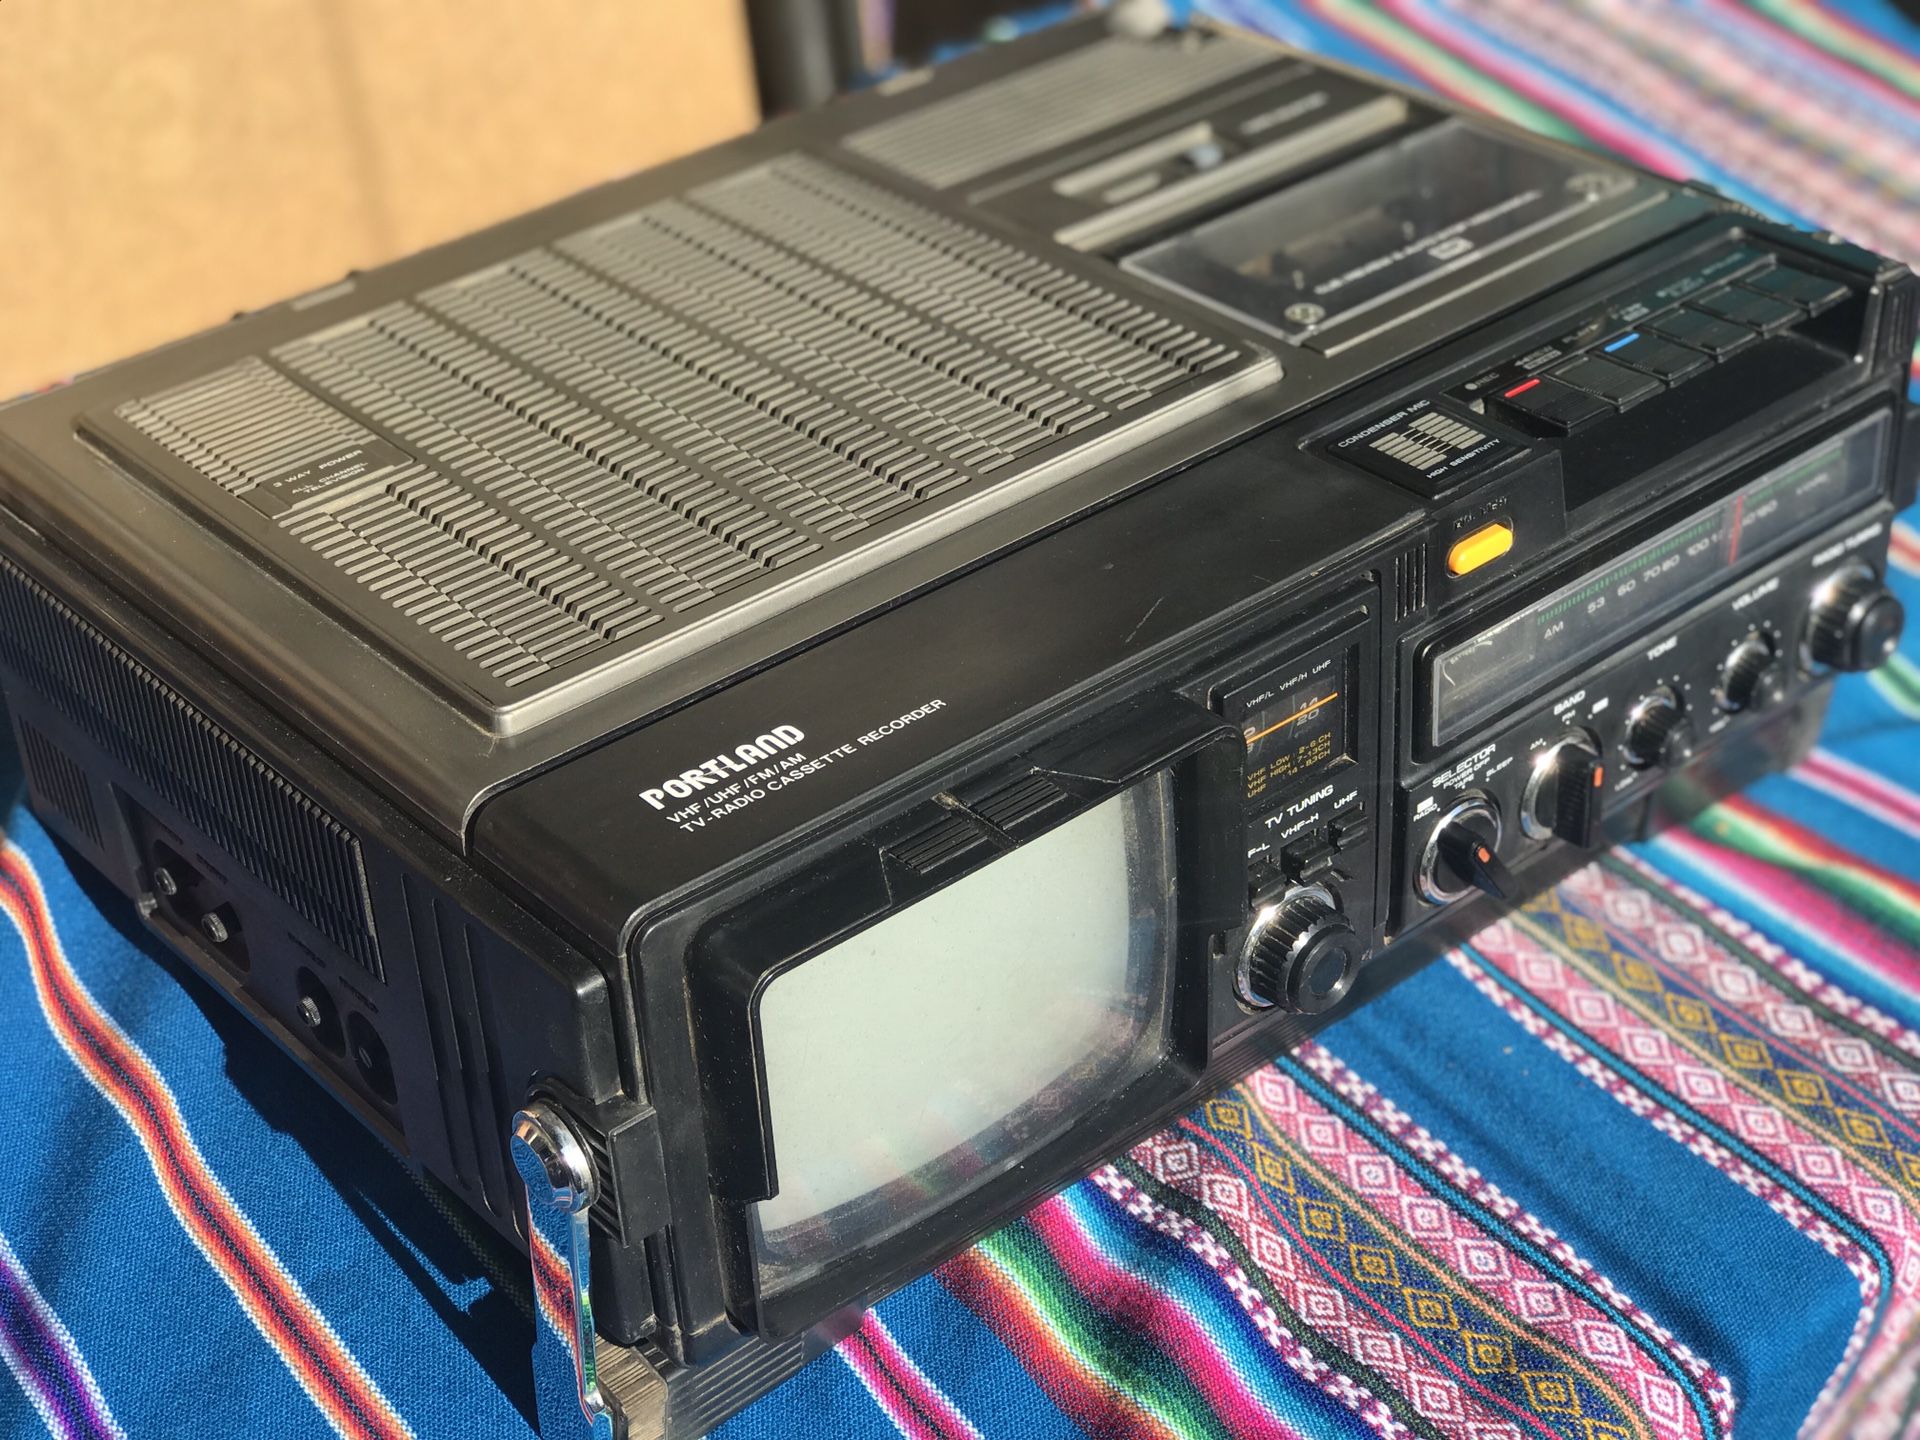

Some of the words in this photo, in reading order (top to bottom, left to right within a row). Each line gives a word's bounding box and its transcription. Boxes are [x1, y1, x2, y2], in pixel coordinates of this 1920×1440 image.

[1337, 410, 1408, 448] CONDENSER
[1407, 399, 1431, 413] MIC
[284, 469, 310, 482] WAY
[318, 449, 363, 469] POWER
[318, 462, 368, 482] CHANNEL
[1426, 466, 1449, 479] HIGH
[1449, 438, 1501, 467] SENSITIVITY
[304, 467, 365, 493] TELEVISION
[1544, 621, 1564, 640] AM
[1587, 596, 1605, 614] 53
[1617, 579, 1637, 597] 60
[1643, 565, 1661, 582] 70
[1647, 635, 1678, 660] TONE
[1246, 691, 1275, 708] VHF/L
[1279, 672, 1308, 691] VHF/H
[1312, 659, 1331, 674] UHF
[1553, 690, 1586, 715] BAND
[1562, 709, 1576, 722] FM
[638, 724, 805, 811] PORTLAND
[679, 788, 766, 833] TV-RADIO
[767, 743, 857, 792] CASSETTE
[857, 698, 947, 746] RECORDER
[1247, 767, 1266, 781] VHF
[1270, 754, 1290, 769] LOW
[1318, 731, 1331, 744] CH
[1432, 743, 1496, 788] SELECTOR
[1486, 756, 1513, 777] SLEEP
[1247, 775, 1266, 789] VHF
[1270, 761, 1291, 778] HIGH
[1443, 767, 1473, 789] POWER
[1473, 757, 1490, 771] OFF
[1454, 773, 1475, 789] TAPE
[1247, 783, 1267, 798] UHF
[1265, 812, 1283, 829] TV
[1286, 784, 1334, 816] TUNING
[1247, 843, 1270, 859] F-L
[1281, 813, 1319, 839] VHF-H
[1334, 790, 1358, 809] UHF
[1413, 803, 1438, 822] RADIO
